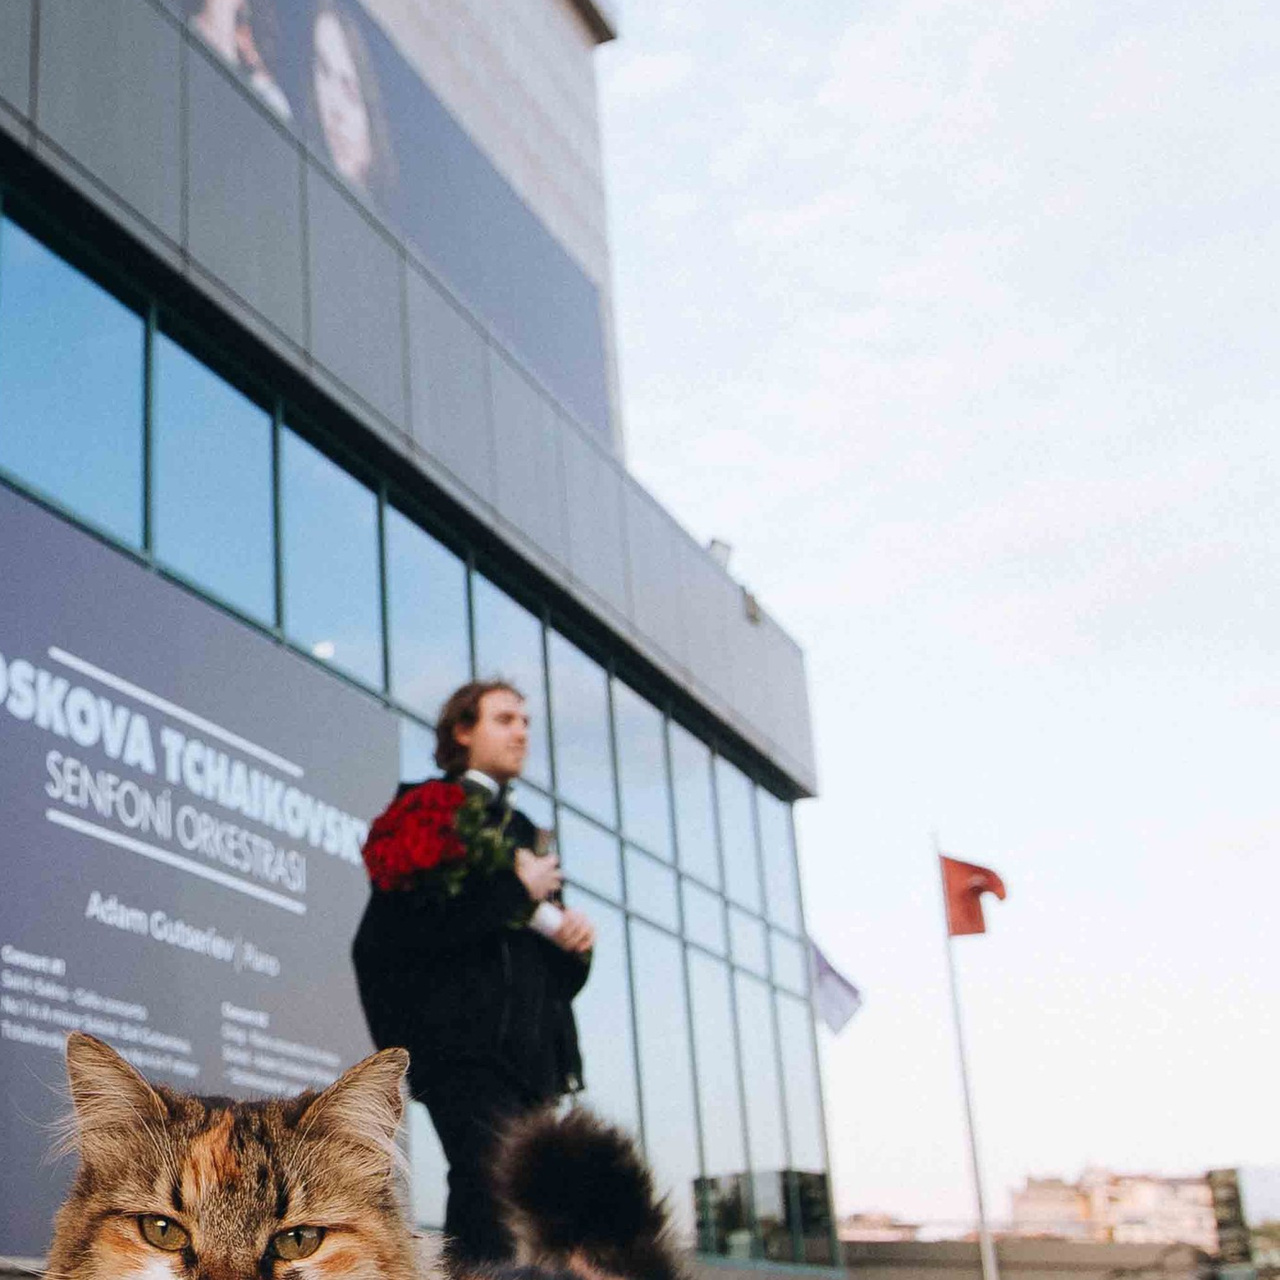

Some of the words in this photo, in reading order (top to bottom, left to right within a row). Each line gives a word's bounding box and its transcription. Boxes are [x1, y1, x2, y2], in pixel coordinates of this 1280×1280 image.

[45, 750, 173, 842] SENFONİ
[176, 804, 307, 894] ORKESTRASI
[160, 725, 369, 866] TCHAIKOVSK
